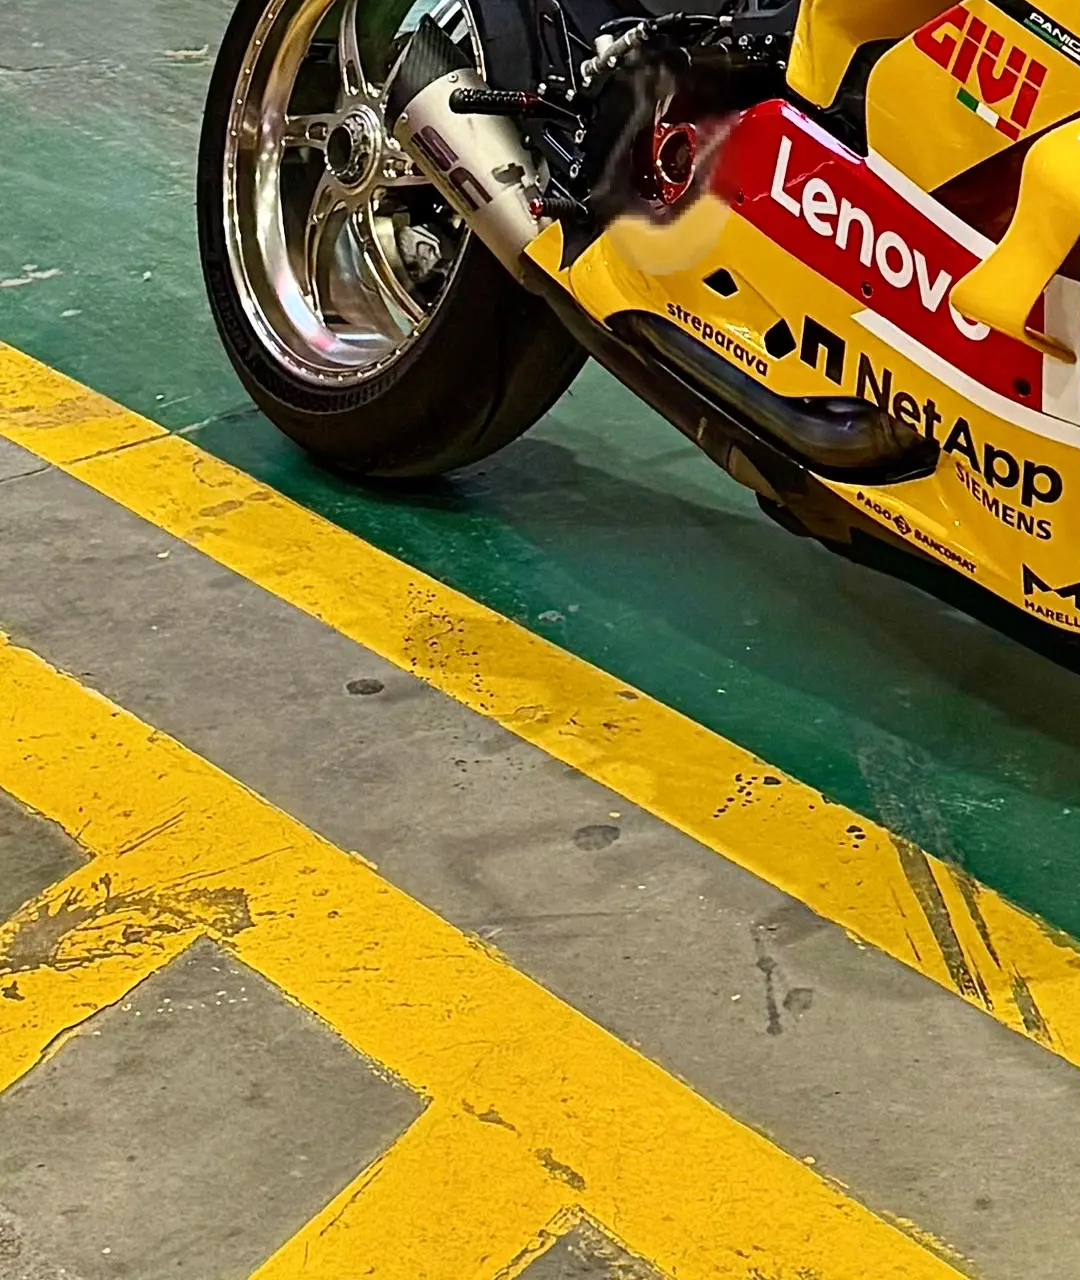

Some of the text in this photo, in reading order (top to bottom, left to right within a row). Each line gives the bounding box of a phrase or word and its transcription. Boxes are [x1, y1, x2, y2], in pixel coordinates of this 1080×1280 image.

[911, 4, 1048, 130] GIVI
[666, 302, 769, 378] streparava
[855, 351, 1063, 507] NetApp
[955, 466, 1052, 541] SIEMENS
[914, 528, 977, 574] BANCOMAT
